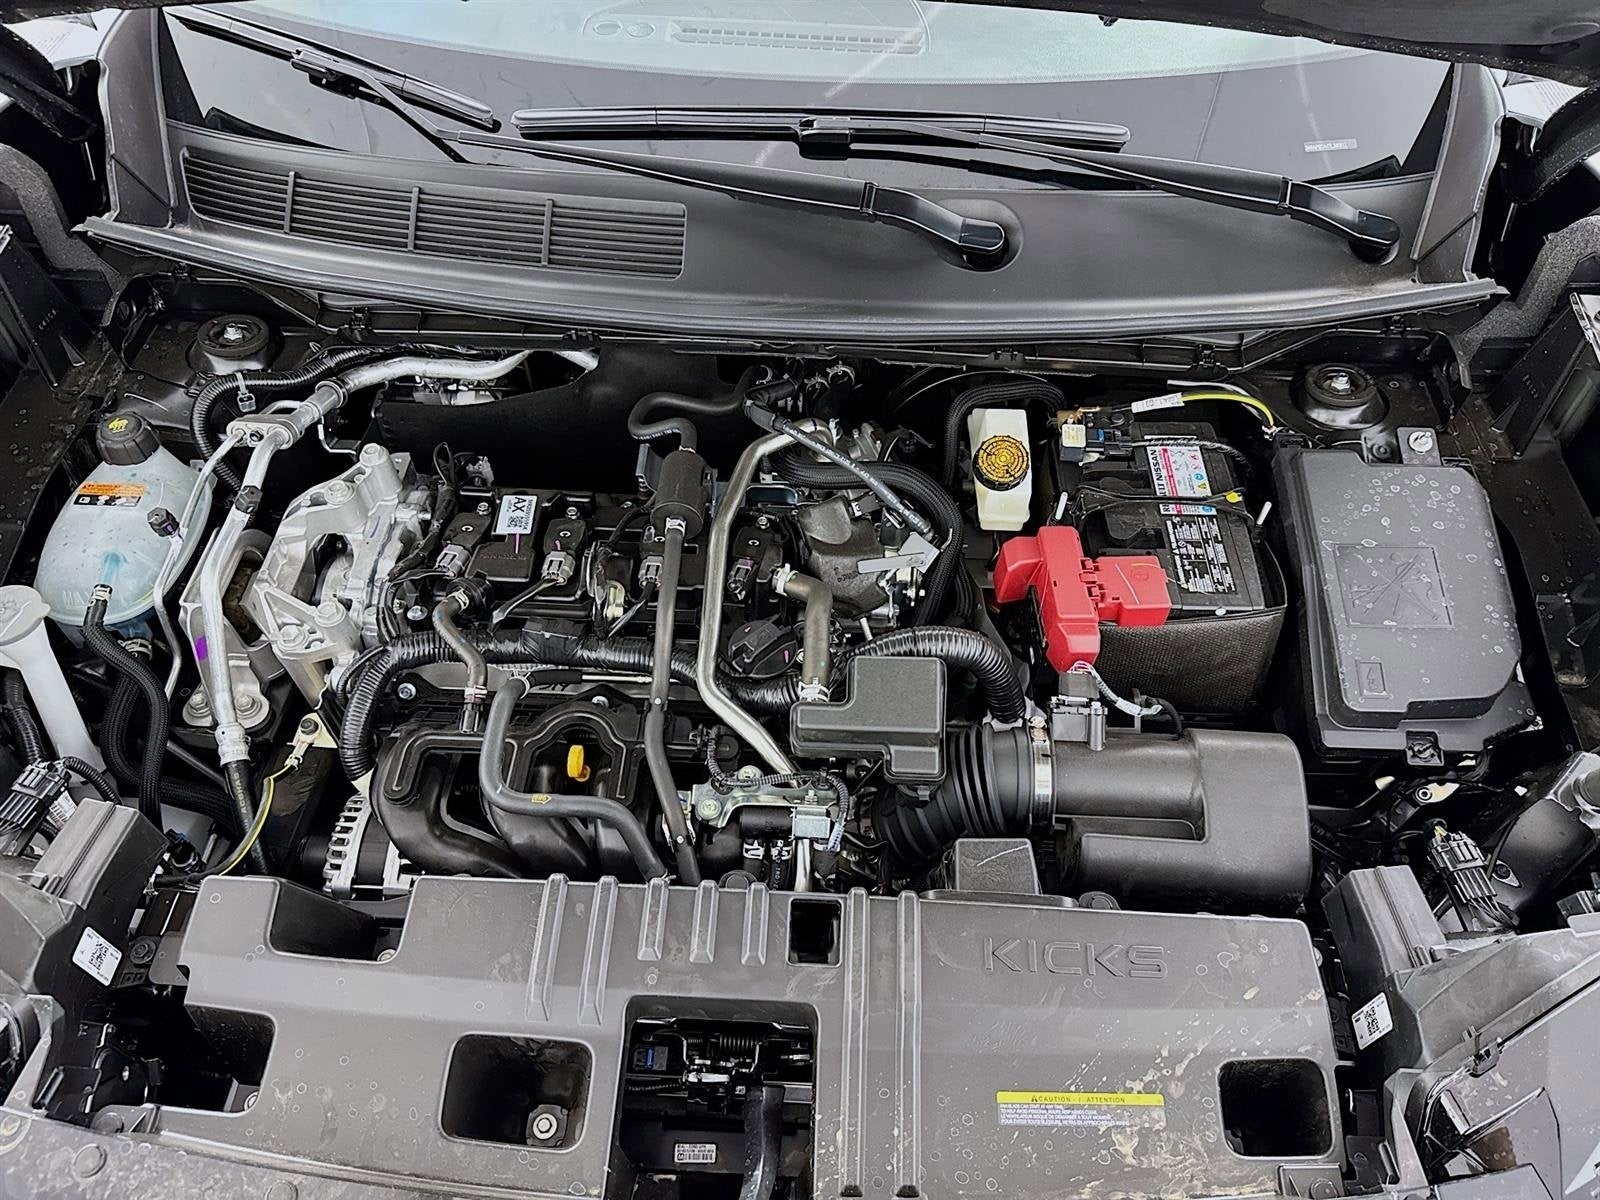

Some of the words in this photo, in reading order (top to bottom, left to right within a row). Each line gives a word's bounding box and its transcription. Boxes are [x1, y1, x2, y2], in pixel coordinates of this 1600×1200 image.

[1150, 450, 1163, 482] NISSAN
[512, 497, 527, 512] AX
[983, 937, 1168, 979] KICKS
